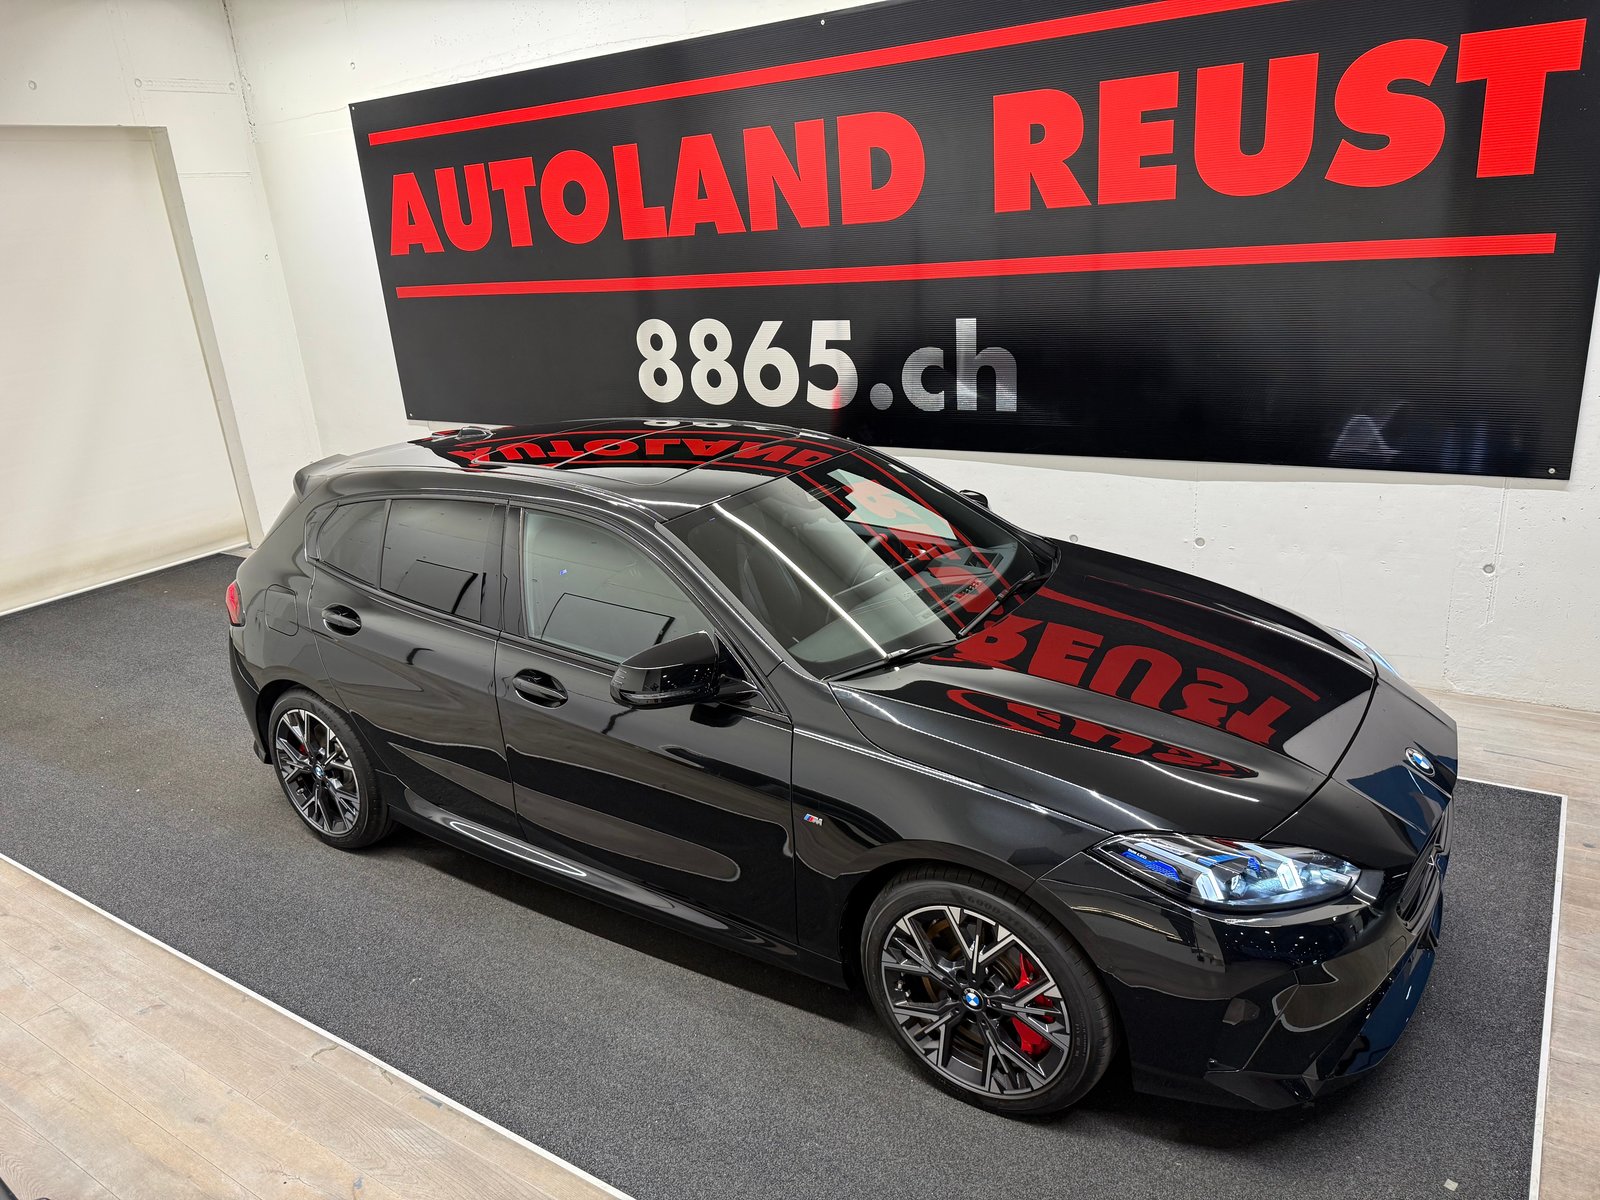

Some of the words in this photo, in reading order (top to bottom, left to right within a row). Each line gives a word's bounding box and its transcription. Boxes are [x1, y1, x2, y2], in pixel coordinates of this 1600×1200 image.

[390, 111, 926, 256] AUTOLAND
[993, 18, 1587, 213] REUST
[636, 318, 1018, 413] 8865.ch
